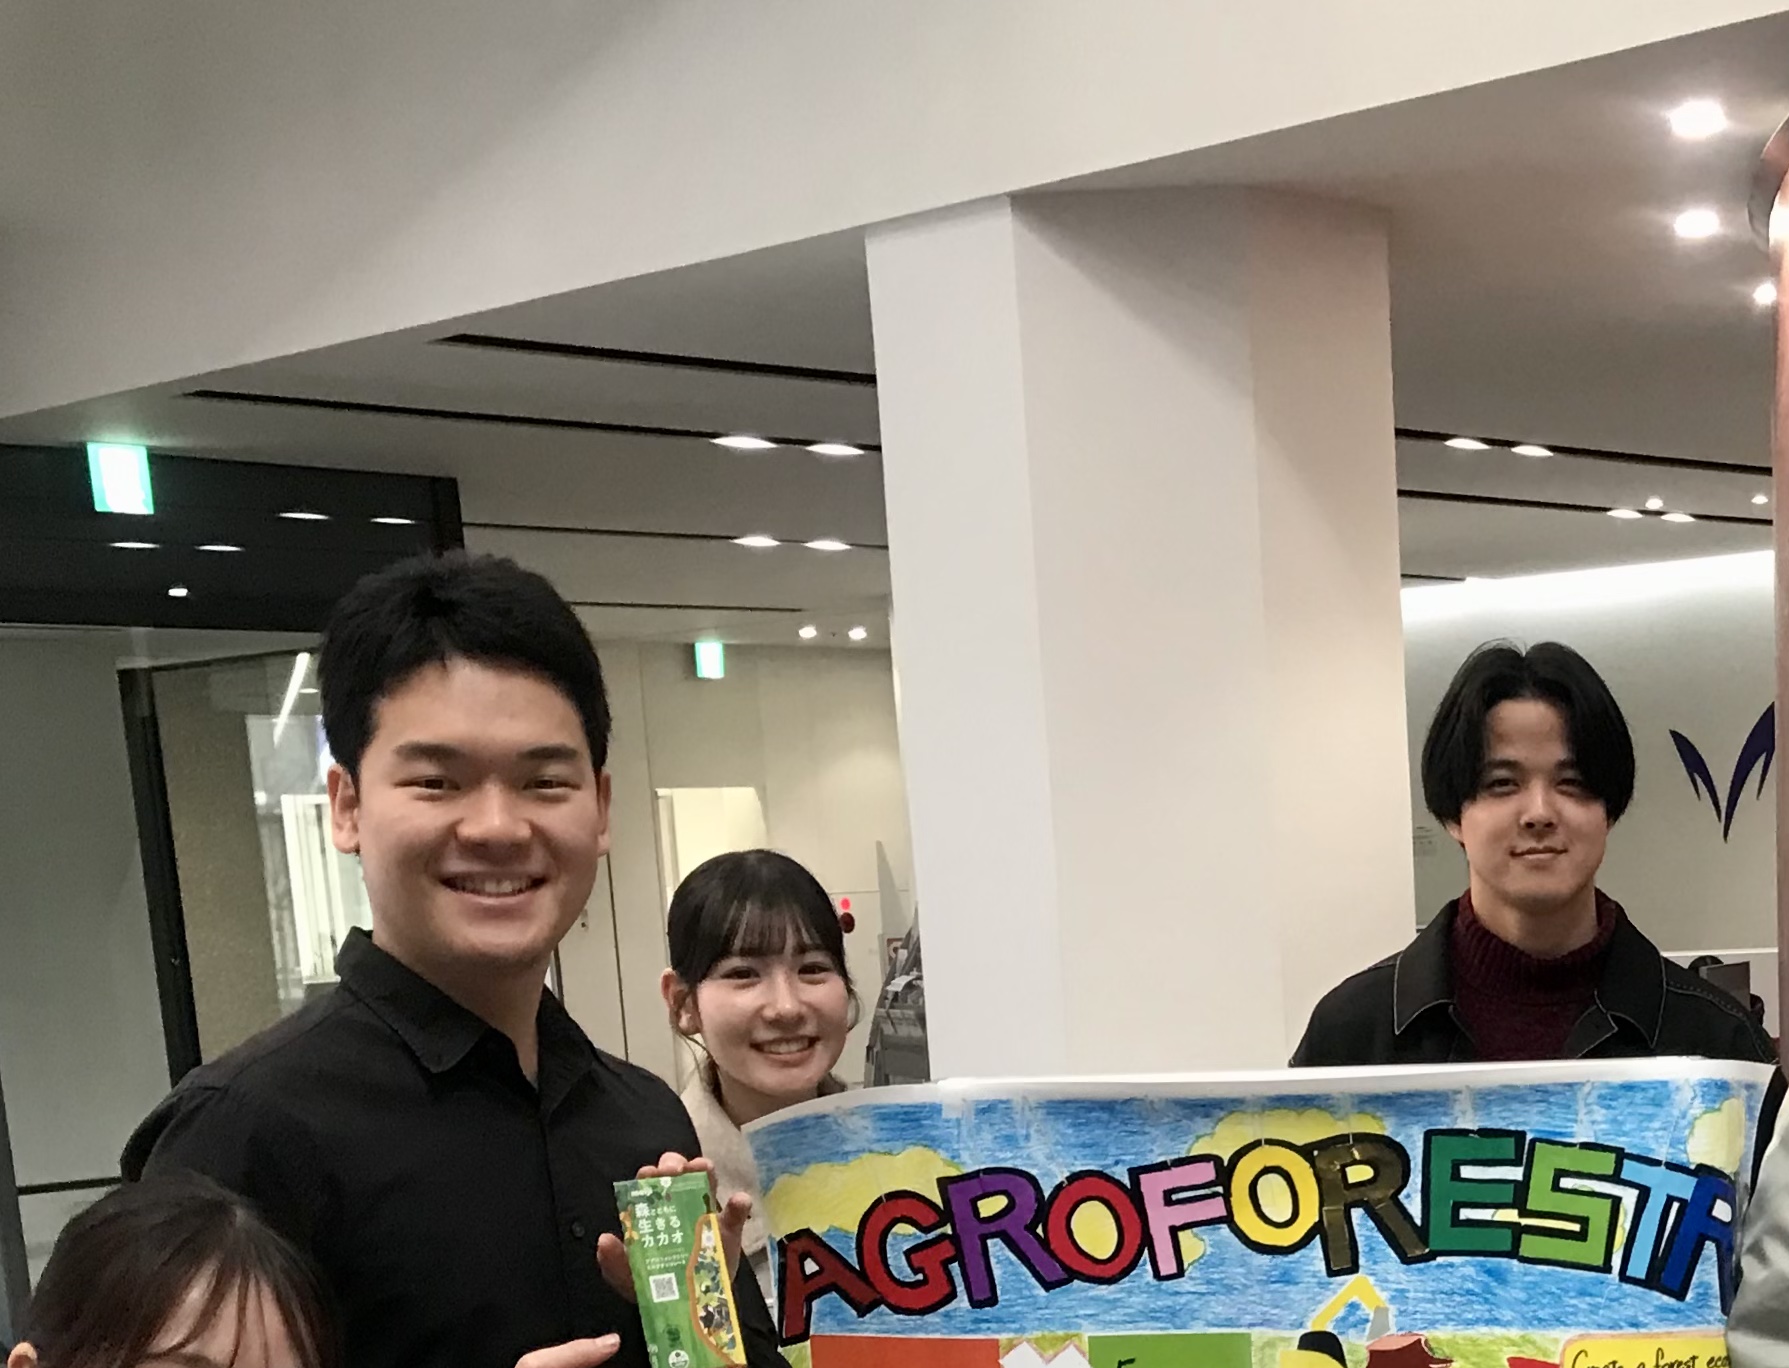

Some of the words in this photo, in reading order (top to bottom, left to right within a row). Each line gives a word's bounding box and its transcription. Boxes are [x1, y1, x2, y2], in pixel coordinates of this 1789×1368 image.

[638, 1216, 681, 1233] 生きる
[642, 1229, 684, 1248] カカオ
